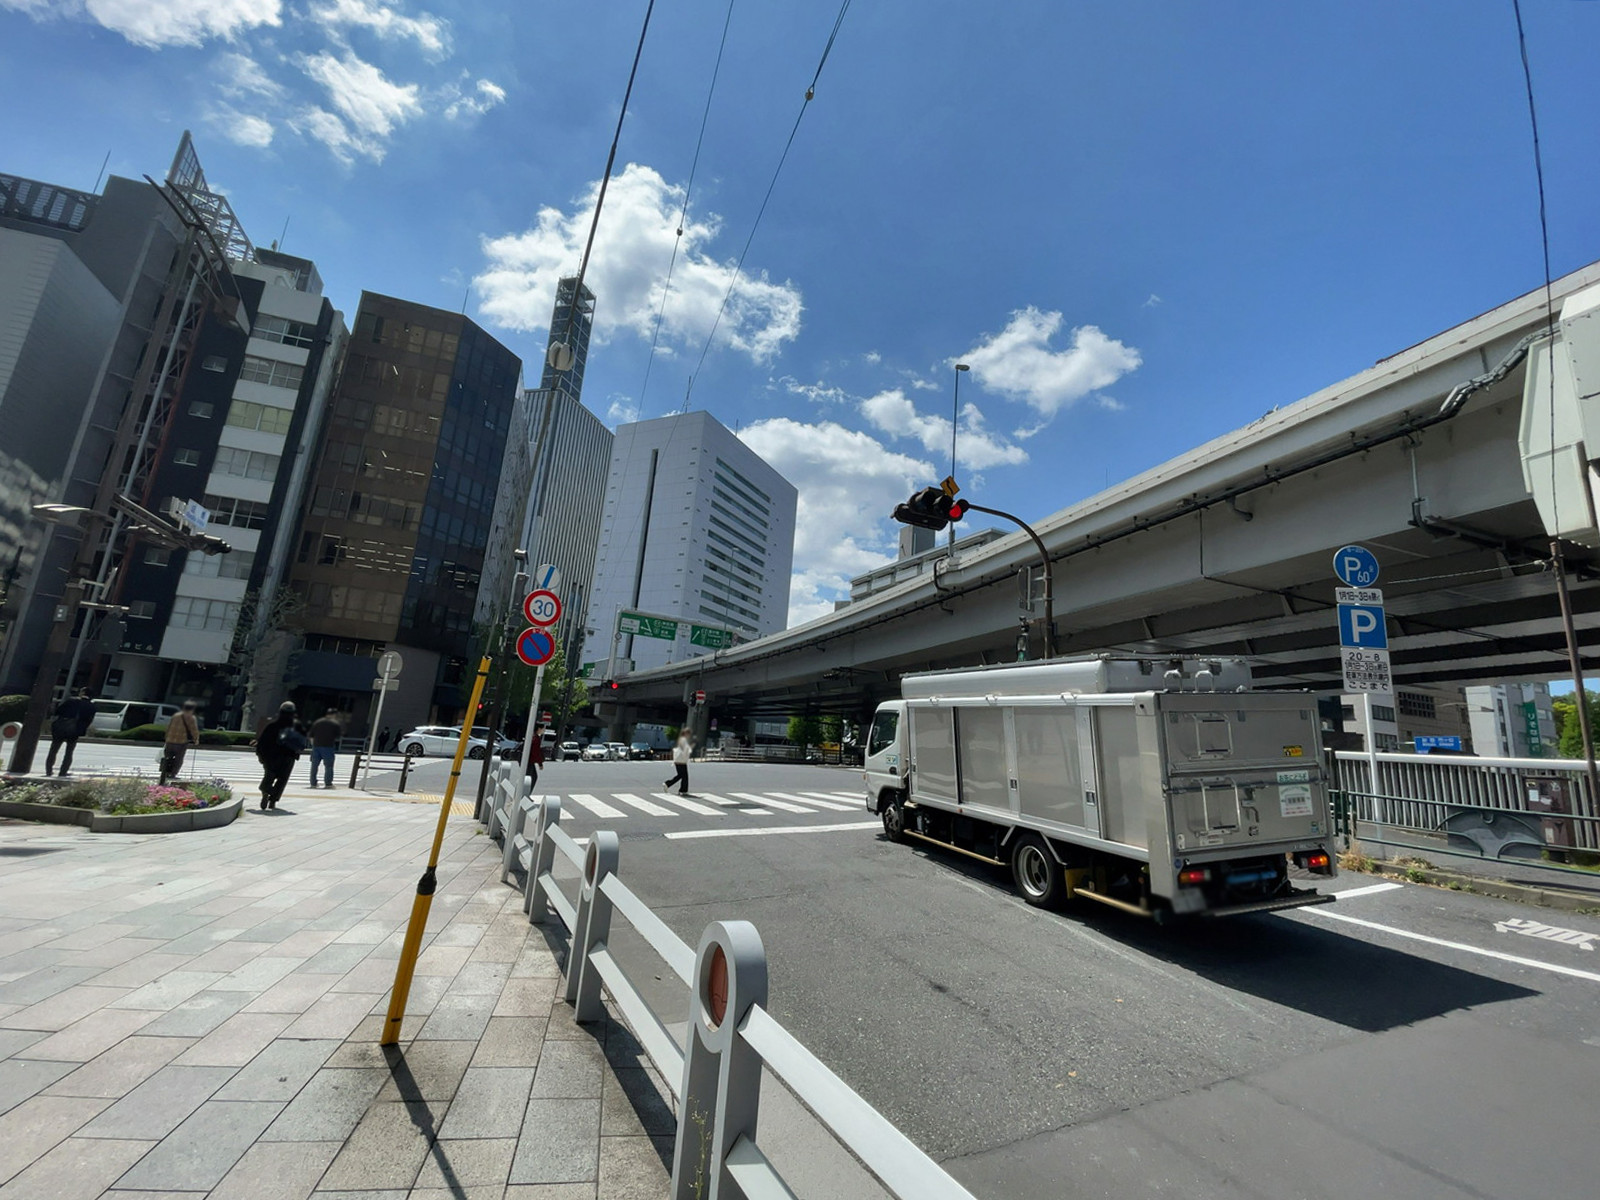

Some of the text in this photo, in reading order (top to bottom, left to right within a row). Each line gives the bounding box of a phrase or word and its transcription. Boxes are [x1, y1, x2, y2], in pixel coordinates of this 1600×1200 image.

[1344, 556, 1361, 582] P
[532, 599, 554, 618] 30
[1350, 609, 1377, 643] P
[1348, 682, 1388, 690] ここまで
